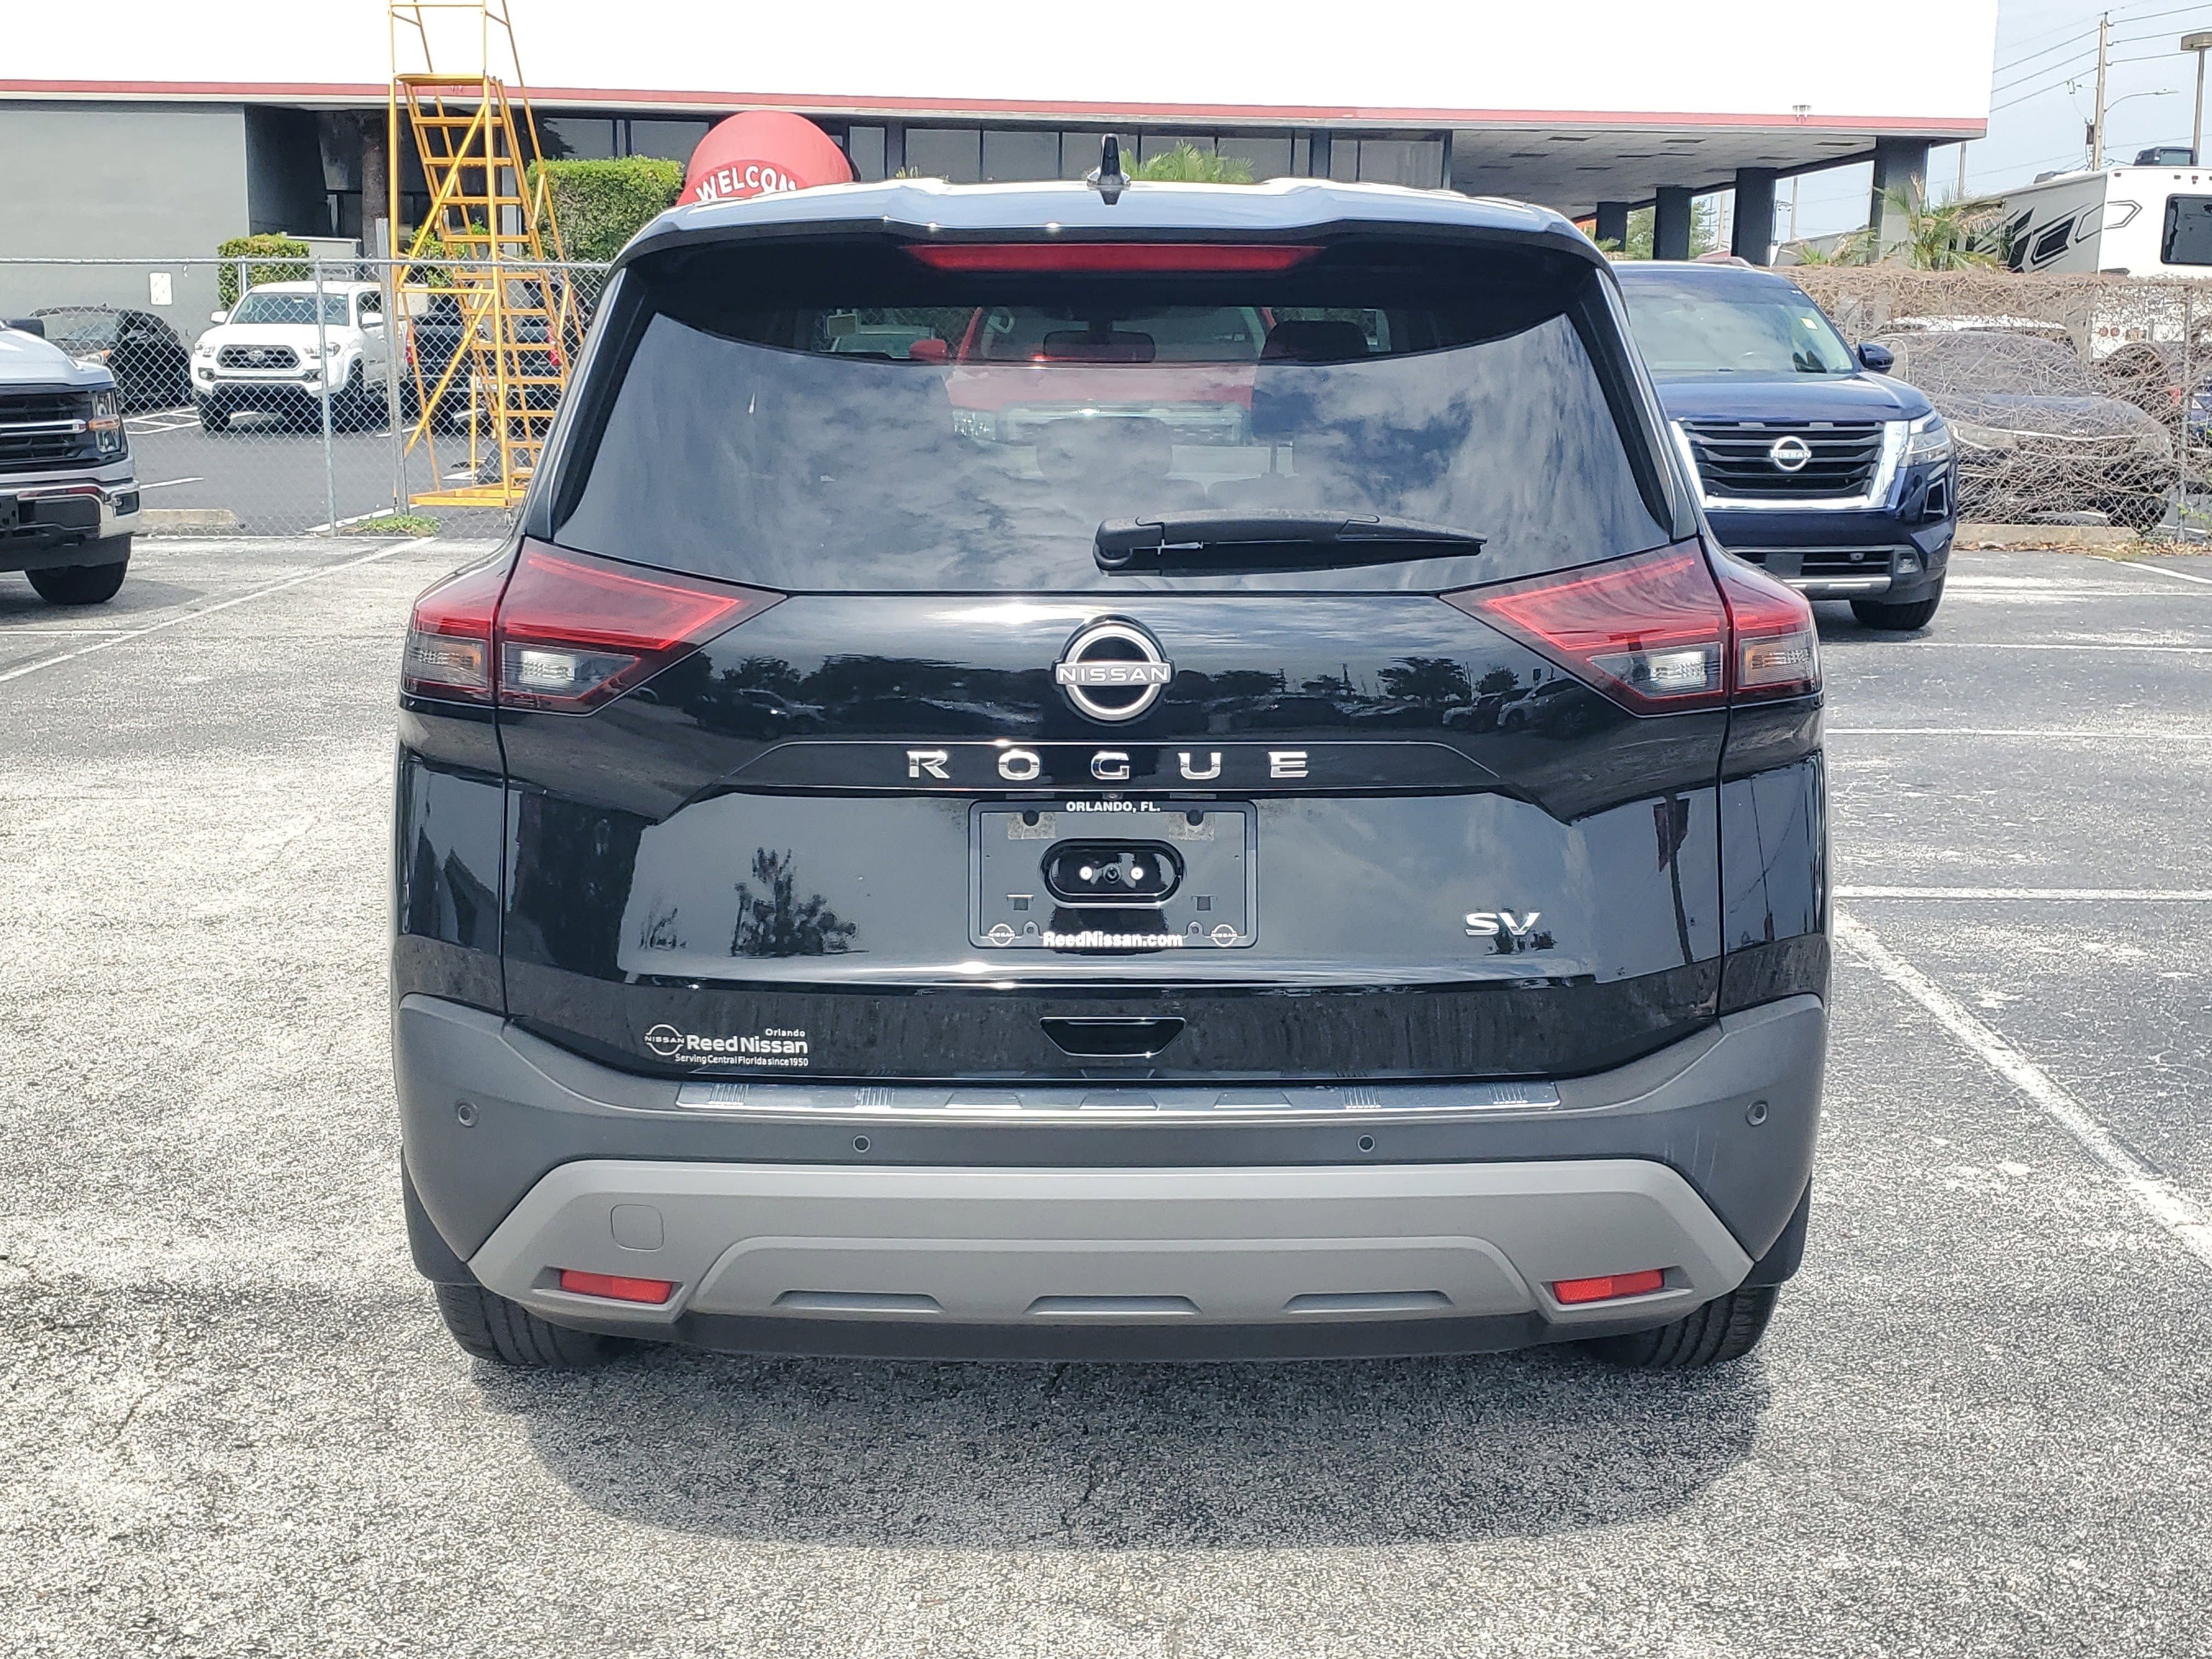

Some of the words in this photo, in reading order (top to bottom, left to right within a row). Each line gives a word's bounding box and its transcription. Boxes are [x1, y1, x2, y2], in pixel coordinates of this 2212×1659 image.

[695, 165, 796, 201] WELCOM
[1059, 667, 1168, 681] NISSAN
[907, 751, 1310, 780] ROGUE
[1066, 801, 1137, 813] ORLANDO,
[1141, 802, 1161, 811] FL.
[1465, 912, 1540, 936] SV
[1043, 930, 1183, 947] ReedNissan.com
[765, 1028, 805, 1036] Orlando
[687, 1035, 738, 1052] Reed
[740, 1036, 808, 1054] Nissan
[675, 1053, 707, 1064] Serving
[707, 1055, 737, 1064] Central
[738, 1056, 766, 1065] Florida
[768, 1057, 789, 1065] since
[789, 1058, 809, 1066] 1950
